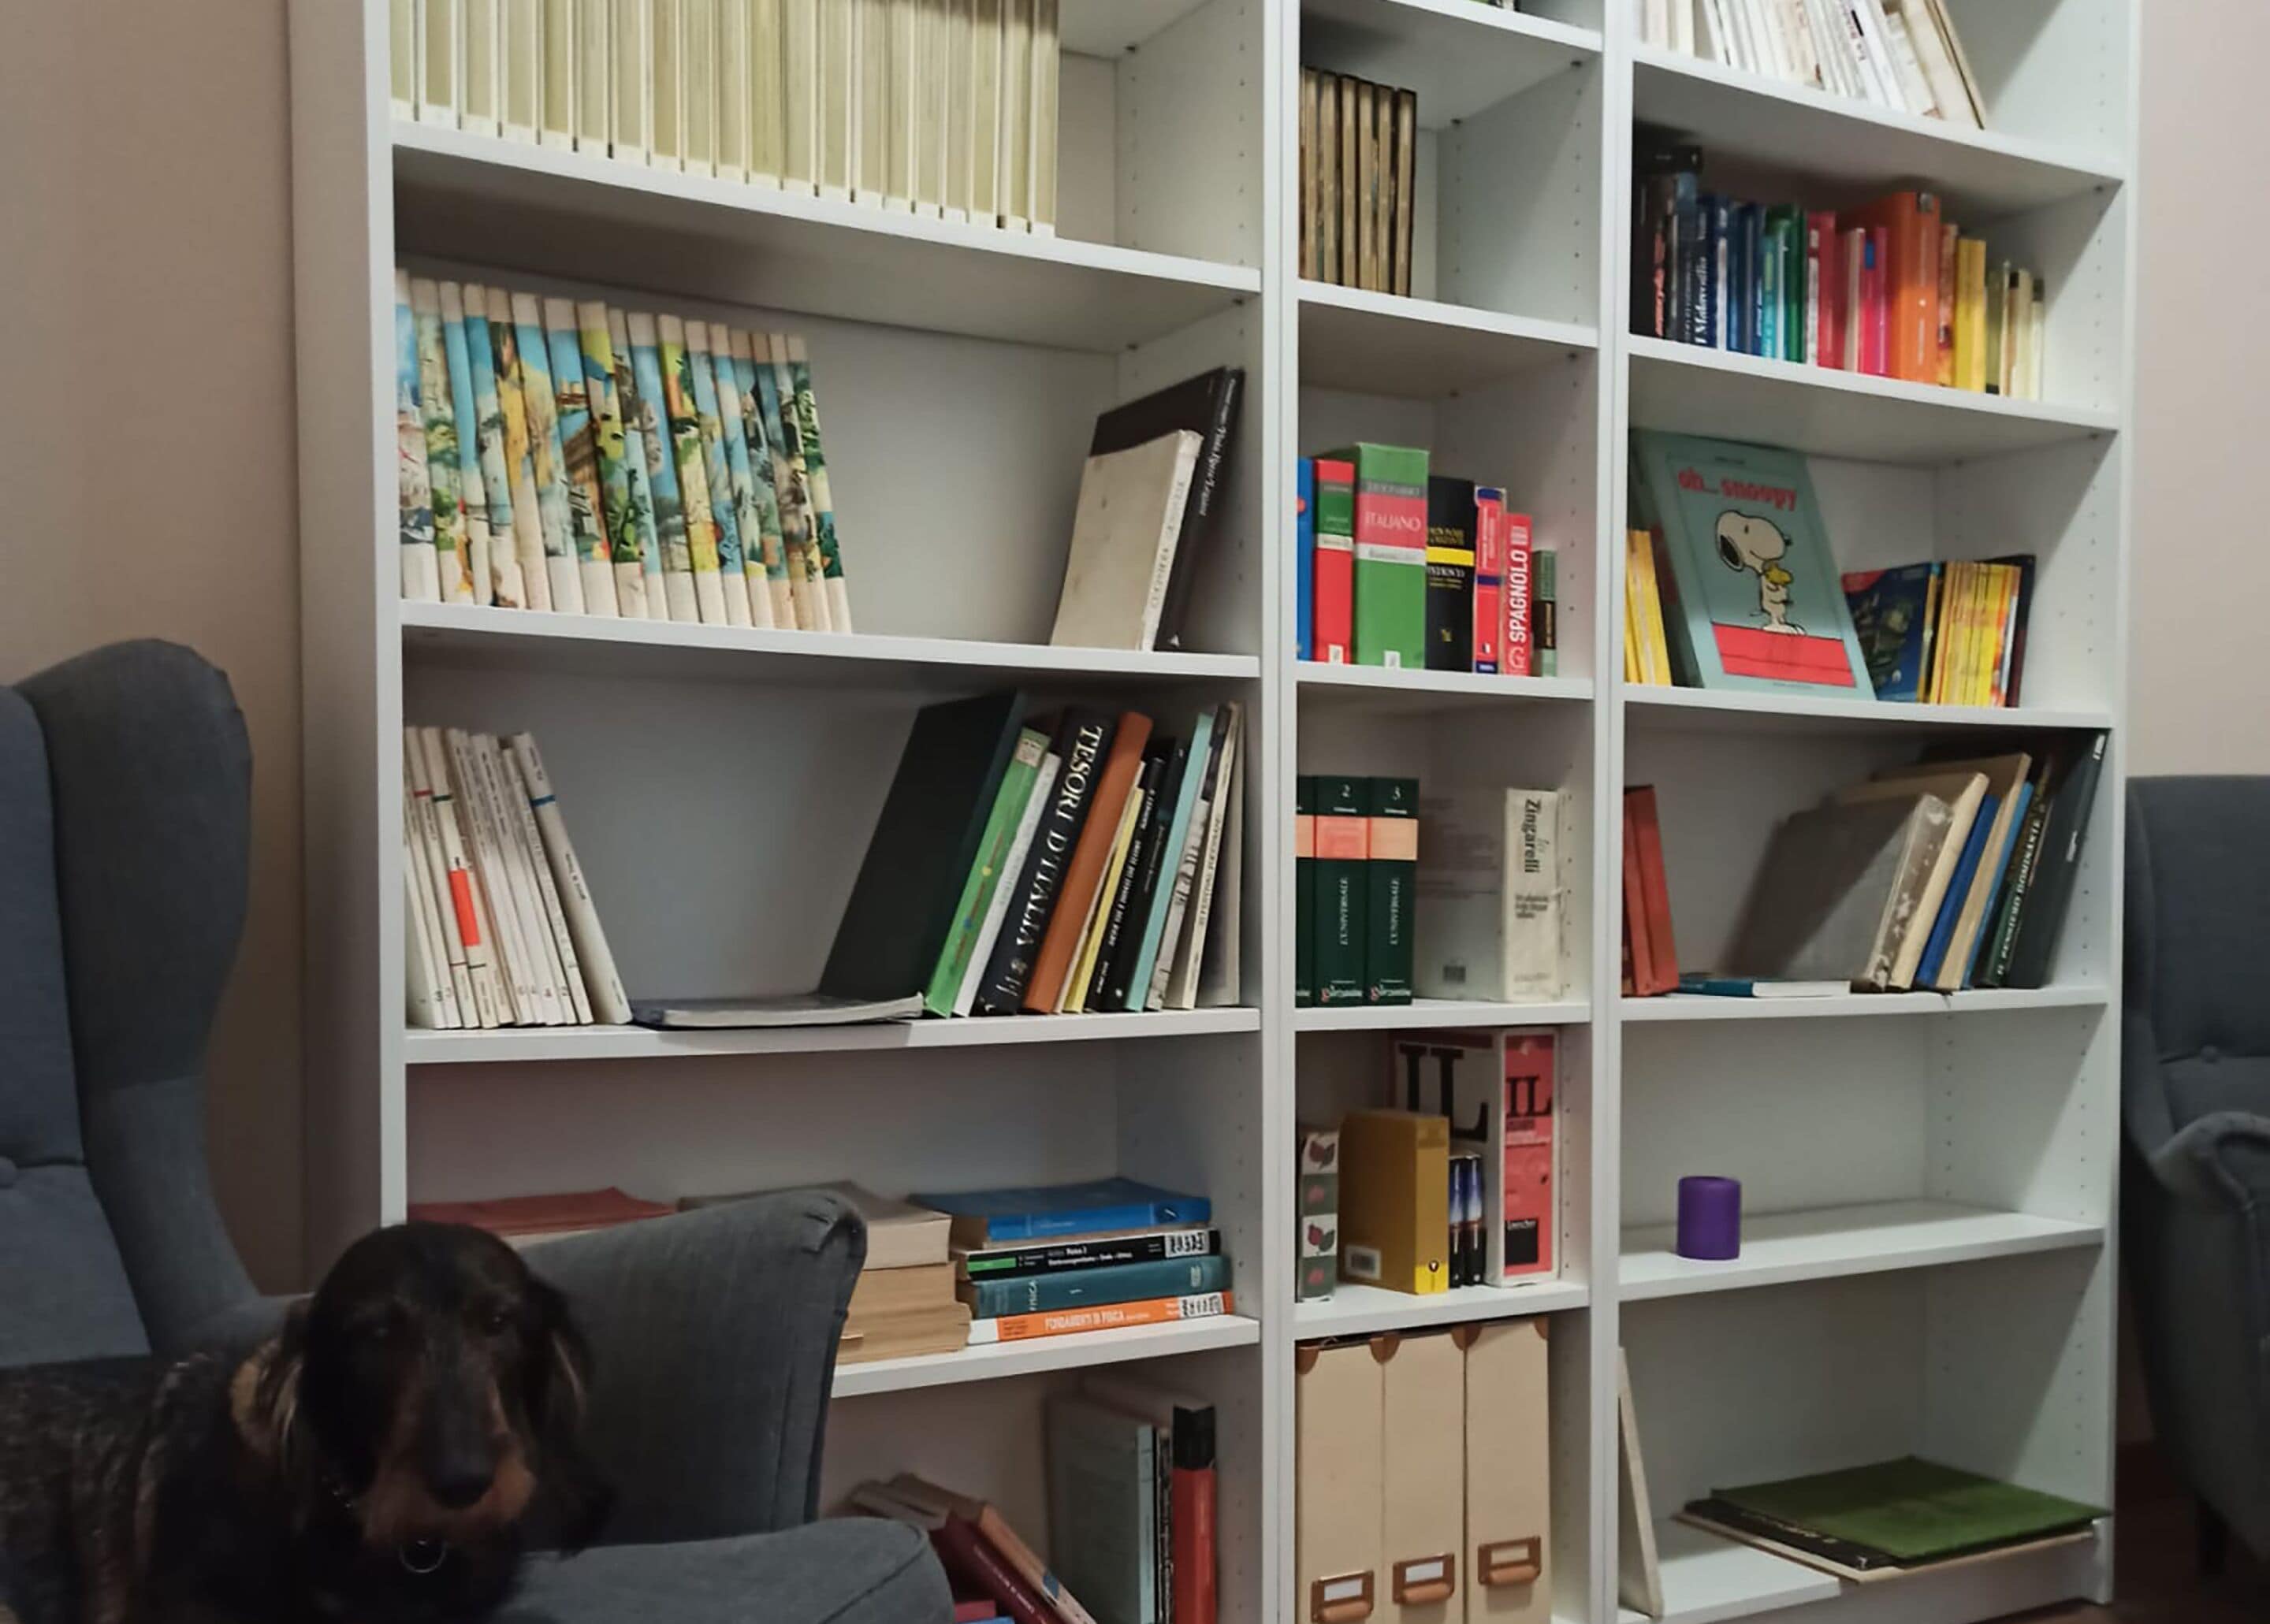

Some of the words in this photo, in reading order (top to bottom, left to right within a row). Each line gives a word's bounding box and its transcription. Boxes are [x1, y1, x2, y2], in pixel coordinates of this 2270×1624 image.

[1364, 511, 1422, 533] ITALIANO
[1509, 550, 1528, 643] SPAGNOLO
[1054, 724, 1103, 823] TESORI
[1523, 797, 1542, 874] Zingarelli
[1015, 831, 1070, 947] D'ITALIA
[1506, 1075, 1554, 1117] IL
